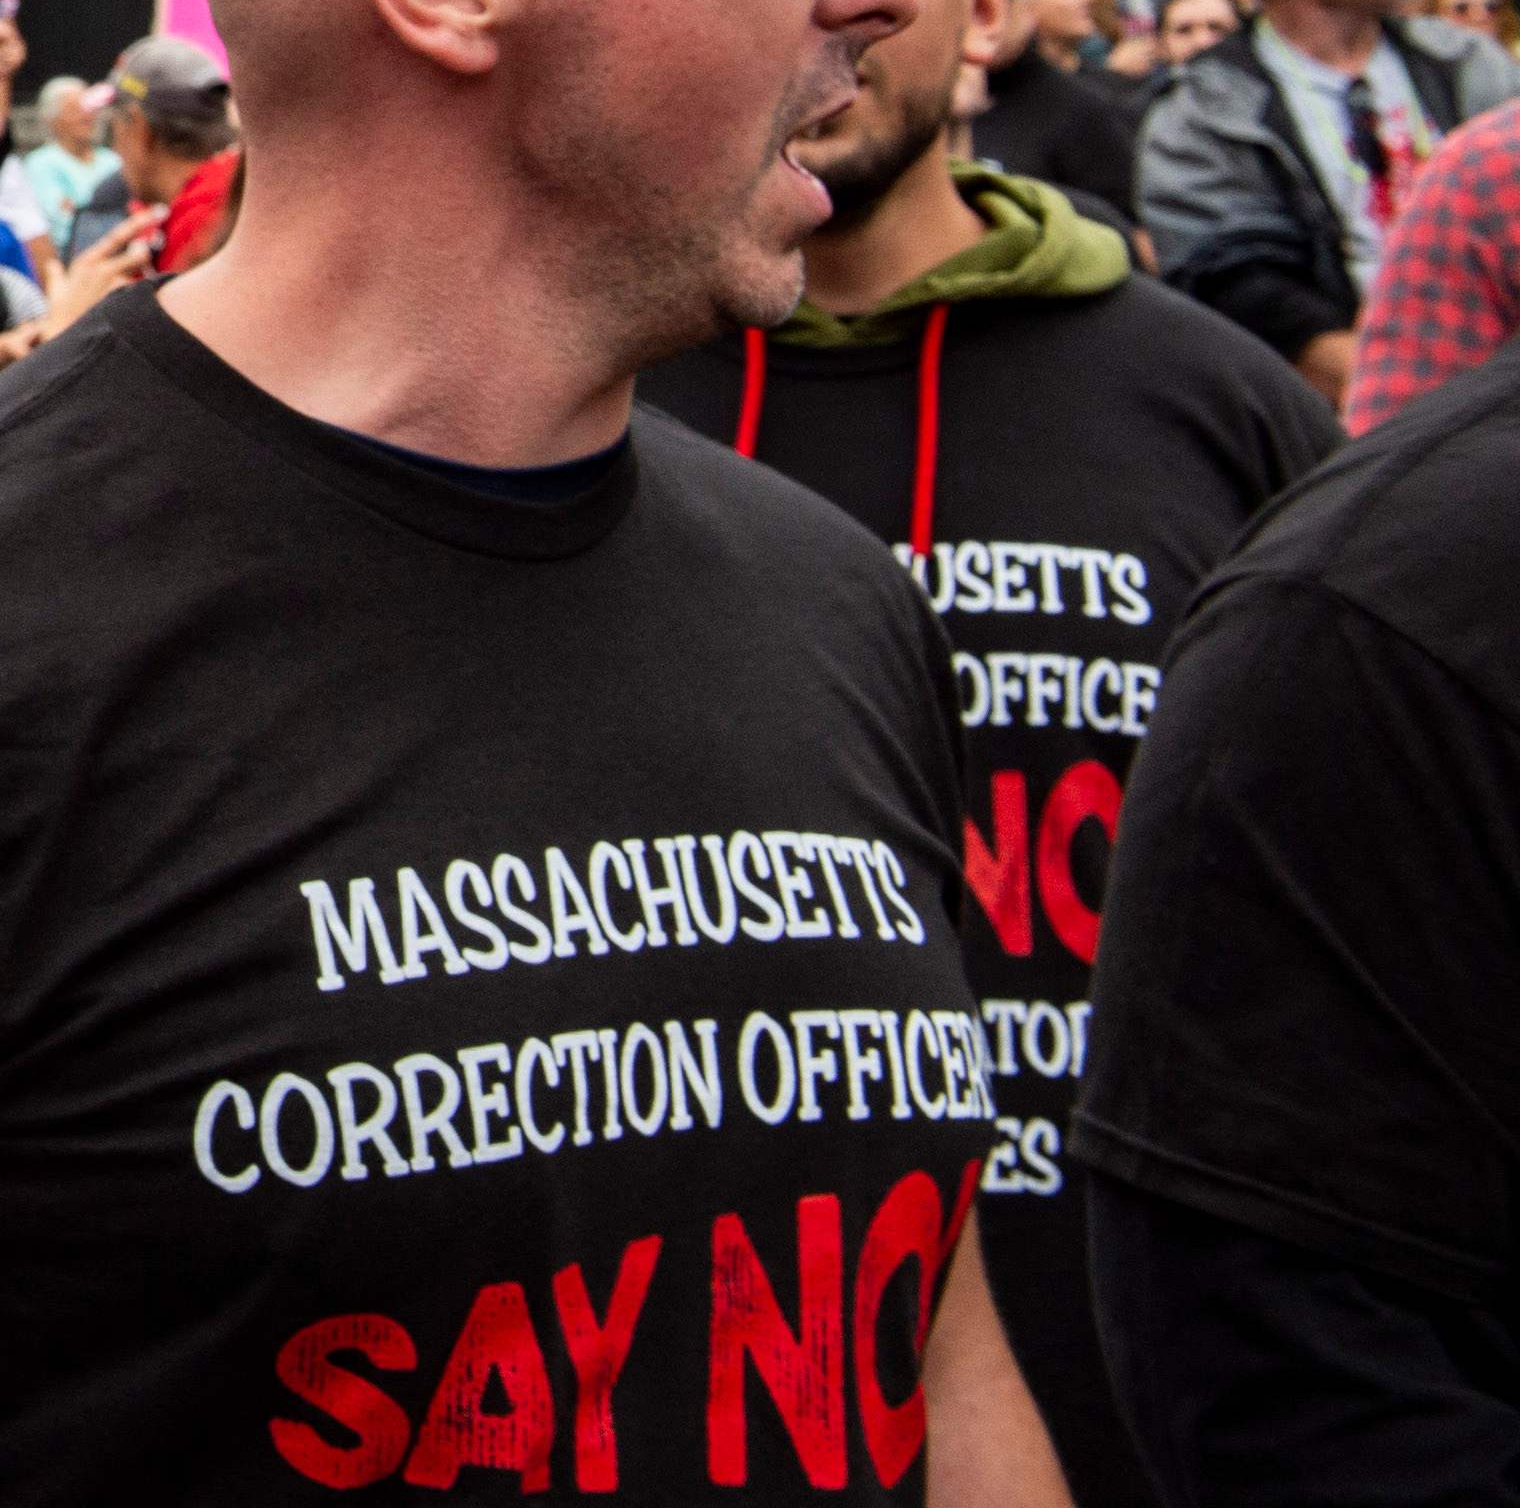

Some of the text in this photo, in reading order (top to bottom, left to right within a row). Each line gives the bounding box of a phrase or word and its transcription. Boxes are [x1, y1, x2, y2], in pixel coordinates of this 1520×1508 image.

[300, 831, 926, 992] MASSACHUSETTS
[194, 1019, 725, 1194] CORRECTION
[269, 1157, 982, 1494] SAY NO
